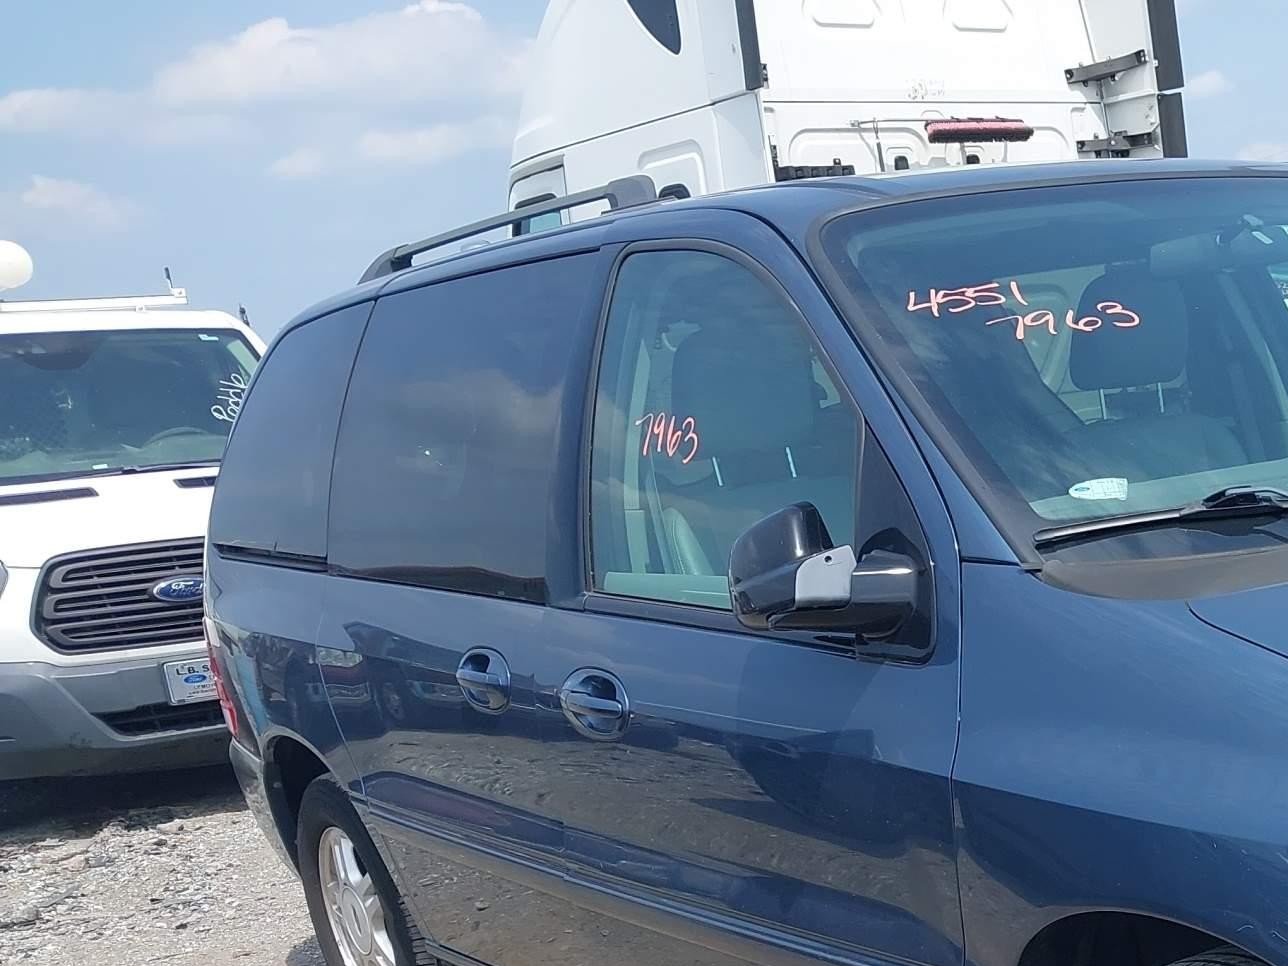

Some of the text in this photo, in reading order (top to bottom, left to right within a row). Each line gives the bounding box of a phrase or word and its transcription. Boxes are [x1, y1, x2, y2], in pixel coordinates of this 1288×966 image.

[907, 281, 1029, 318] 4551
[985, 301, 1140, 341] 7963
[634, 412, 698, 464] 7963
